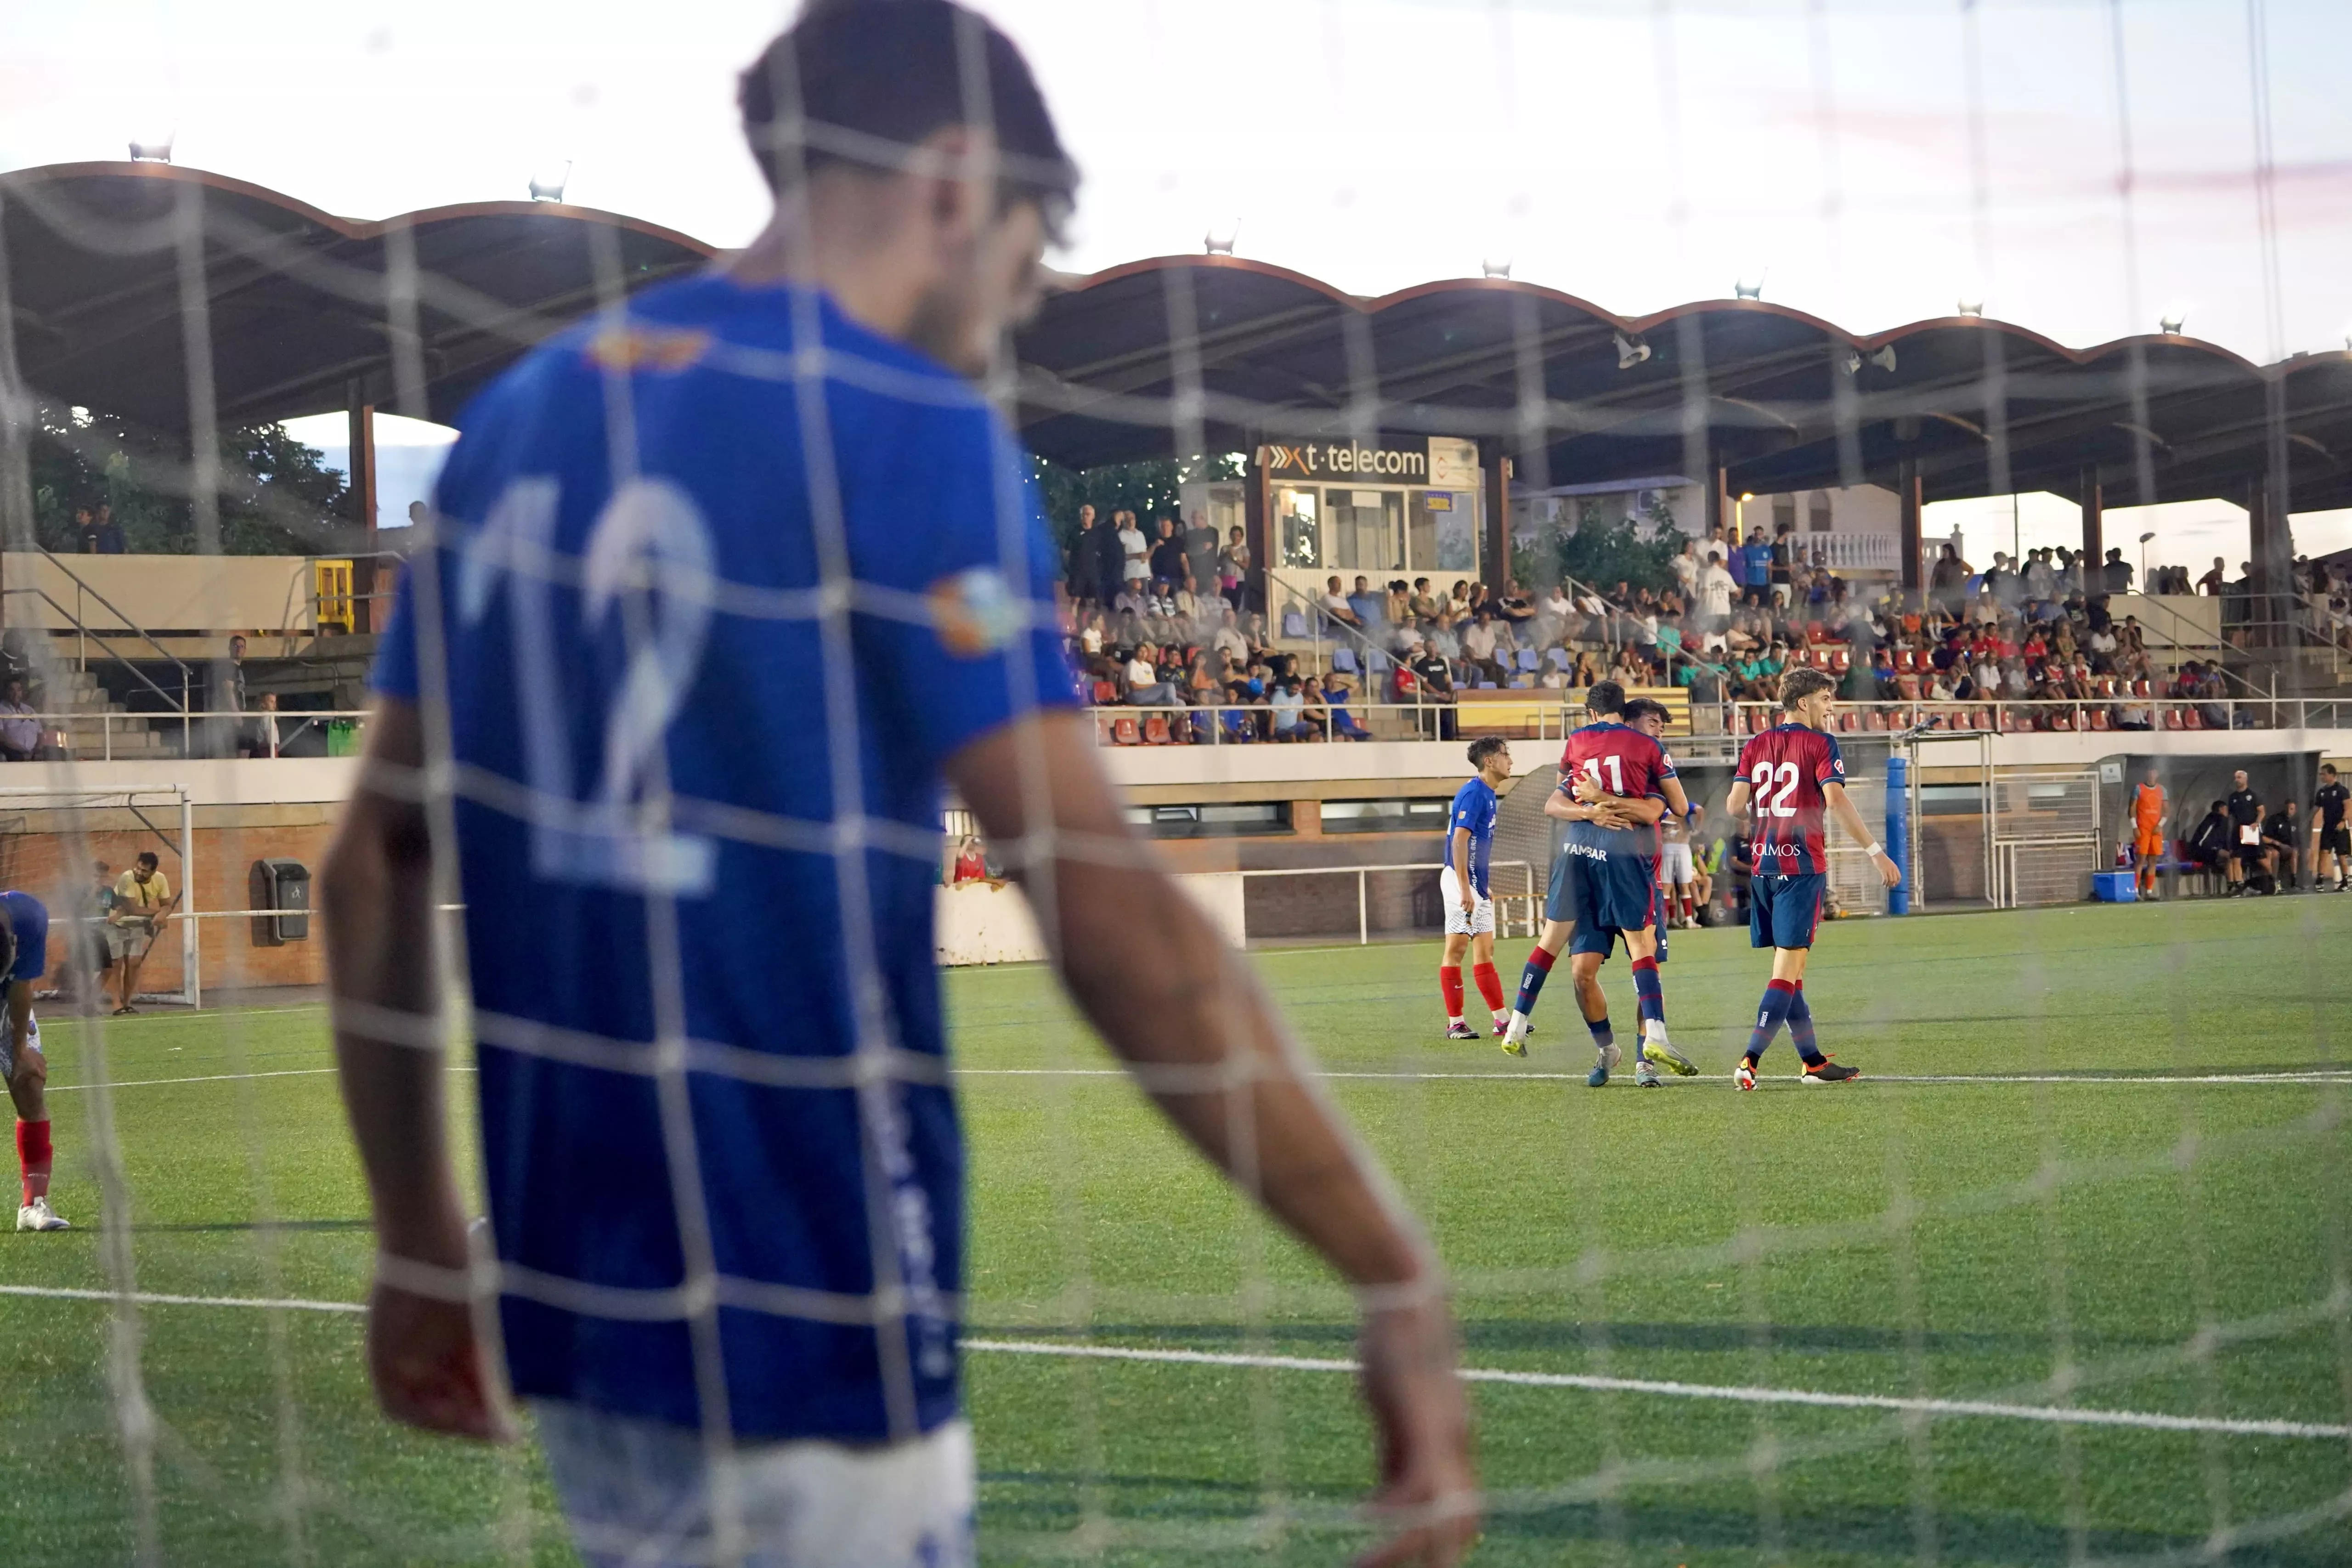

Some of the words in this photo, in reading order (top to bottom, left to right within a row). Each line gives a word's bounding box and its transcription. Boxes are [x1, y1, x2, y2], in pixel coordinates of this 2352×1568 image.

[457, 474, 718, 898] 12
[1583, 755, 1623, 795] 11
[1752, 761, 1799, 817] 22
[1569, 844, 1607, 862] AMBAR
